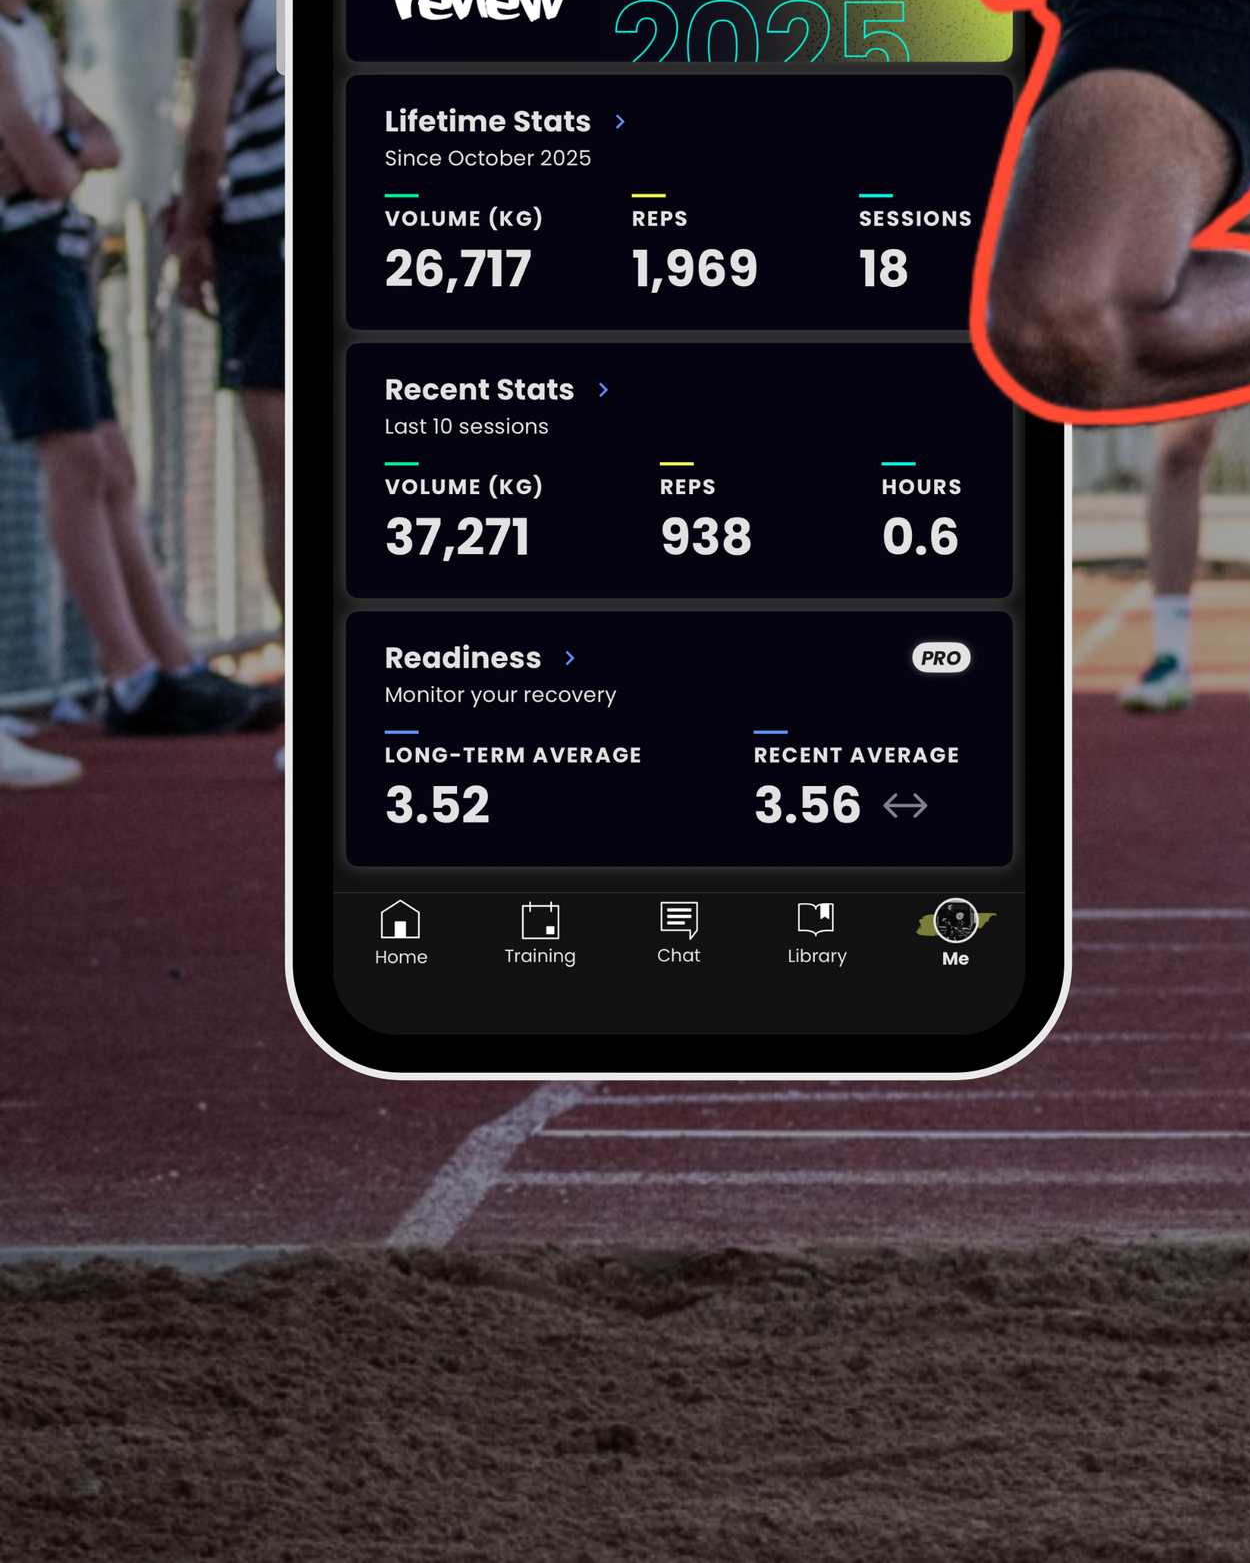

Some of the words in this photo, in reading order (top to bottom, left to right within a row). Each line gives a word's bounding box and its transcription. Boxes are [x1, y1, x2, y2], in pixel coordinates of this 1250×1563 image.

[385, 107, 507, 133] Lifetime
[513, 110, 591, 133] Stats
[385, 148, 442, 167] Since
[448, 149, 535, 167] October
[540, 149, 591, 167] 2025
[384, 210, 480, 227] VOLUME
[488, 205, 542, 231] (KG)
[632, 210, 688, 227] REPS
[859, 210, 972, 227] SESSIONS
[385, 248, 532, 294] 26,717
[632, 248, 758, 294] 1,969
[859, 248, 908, 288] 18
[385, 378, 490, 401] Recent
[497, 378, 575, 401] Stats
[385, 418, 427, 435] Last
[432, 417, 453, 435] 10
[459, 417, 549, 435] sessions
[384, 478, 480, 495] VOLUME
[488, 474, 542, 500] (KG)
[660, 478, 716, 495] REPS
[882, 478, 962, 495] HOURS
[386, 516, 528, 562] 37,271
[661, 516, 752, 556] 938
[883, 516, 959, 556] 0.6
[385, 643, 542, 669] Readiness
[921, 650, 962, 666] PRO
[385, 685, 465, 703] Monitor
[470, 689, 518, 708] your
[524, 689, 617, 708] recovery
[385, 746, 525, 764] LONG-TERM
[532, 746, 641, 764] AVERAGE
[754, 746, 843, 764] RECENT
[849, 746, 959, 764] AVERAGE
[386, 784, 490, 824] 3.52
[755, 784, 861, 824] 3.56
[375, 950, 428, 964] Home
[504, 947, 576, 968] Training
[657, 947, 701, 963] Chat
[788, 948, 848, 968] Library
[942, 951, 970, 966] Me
